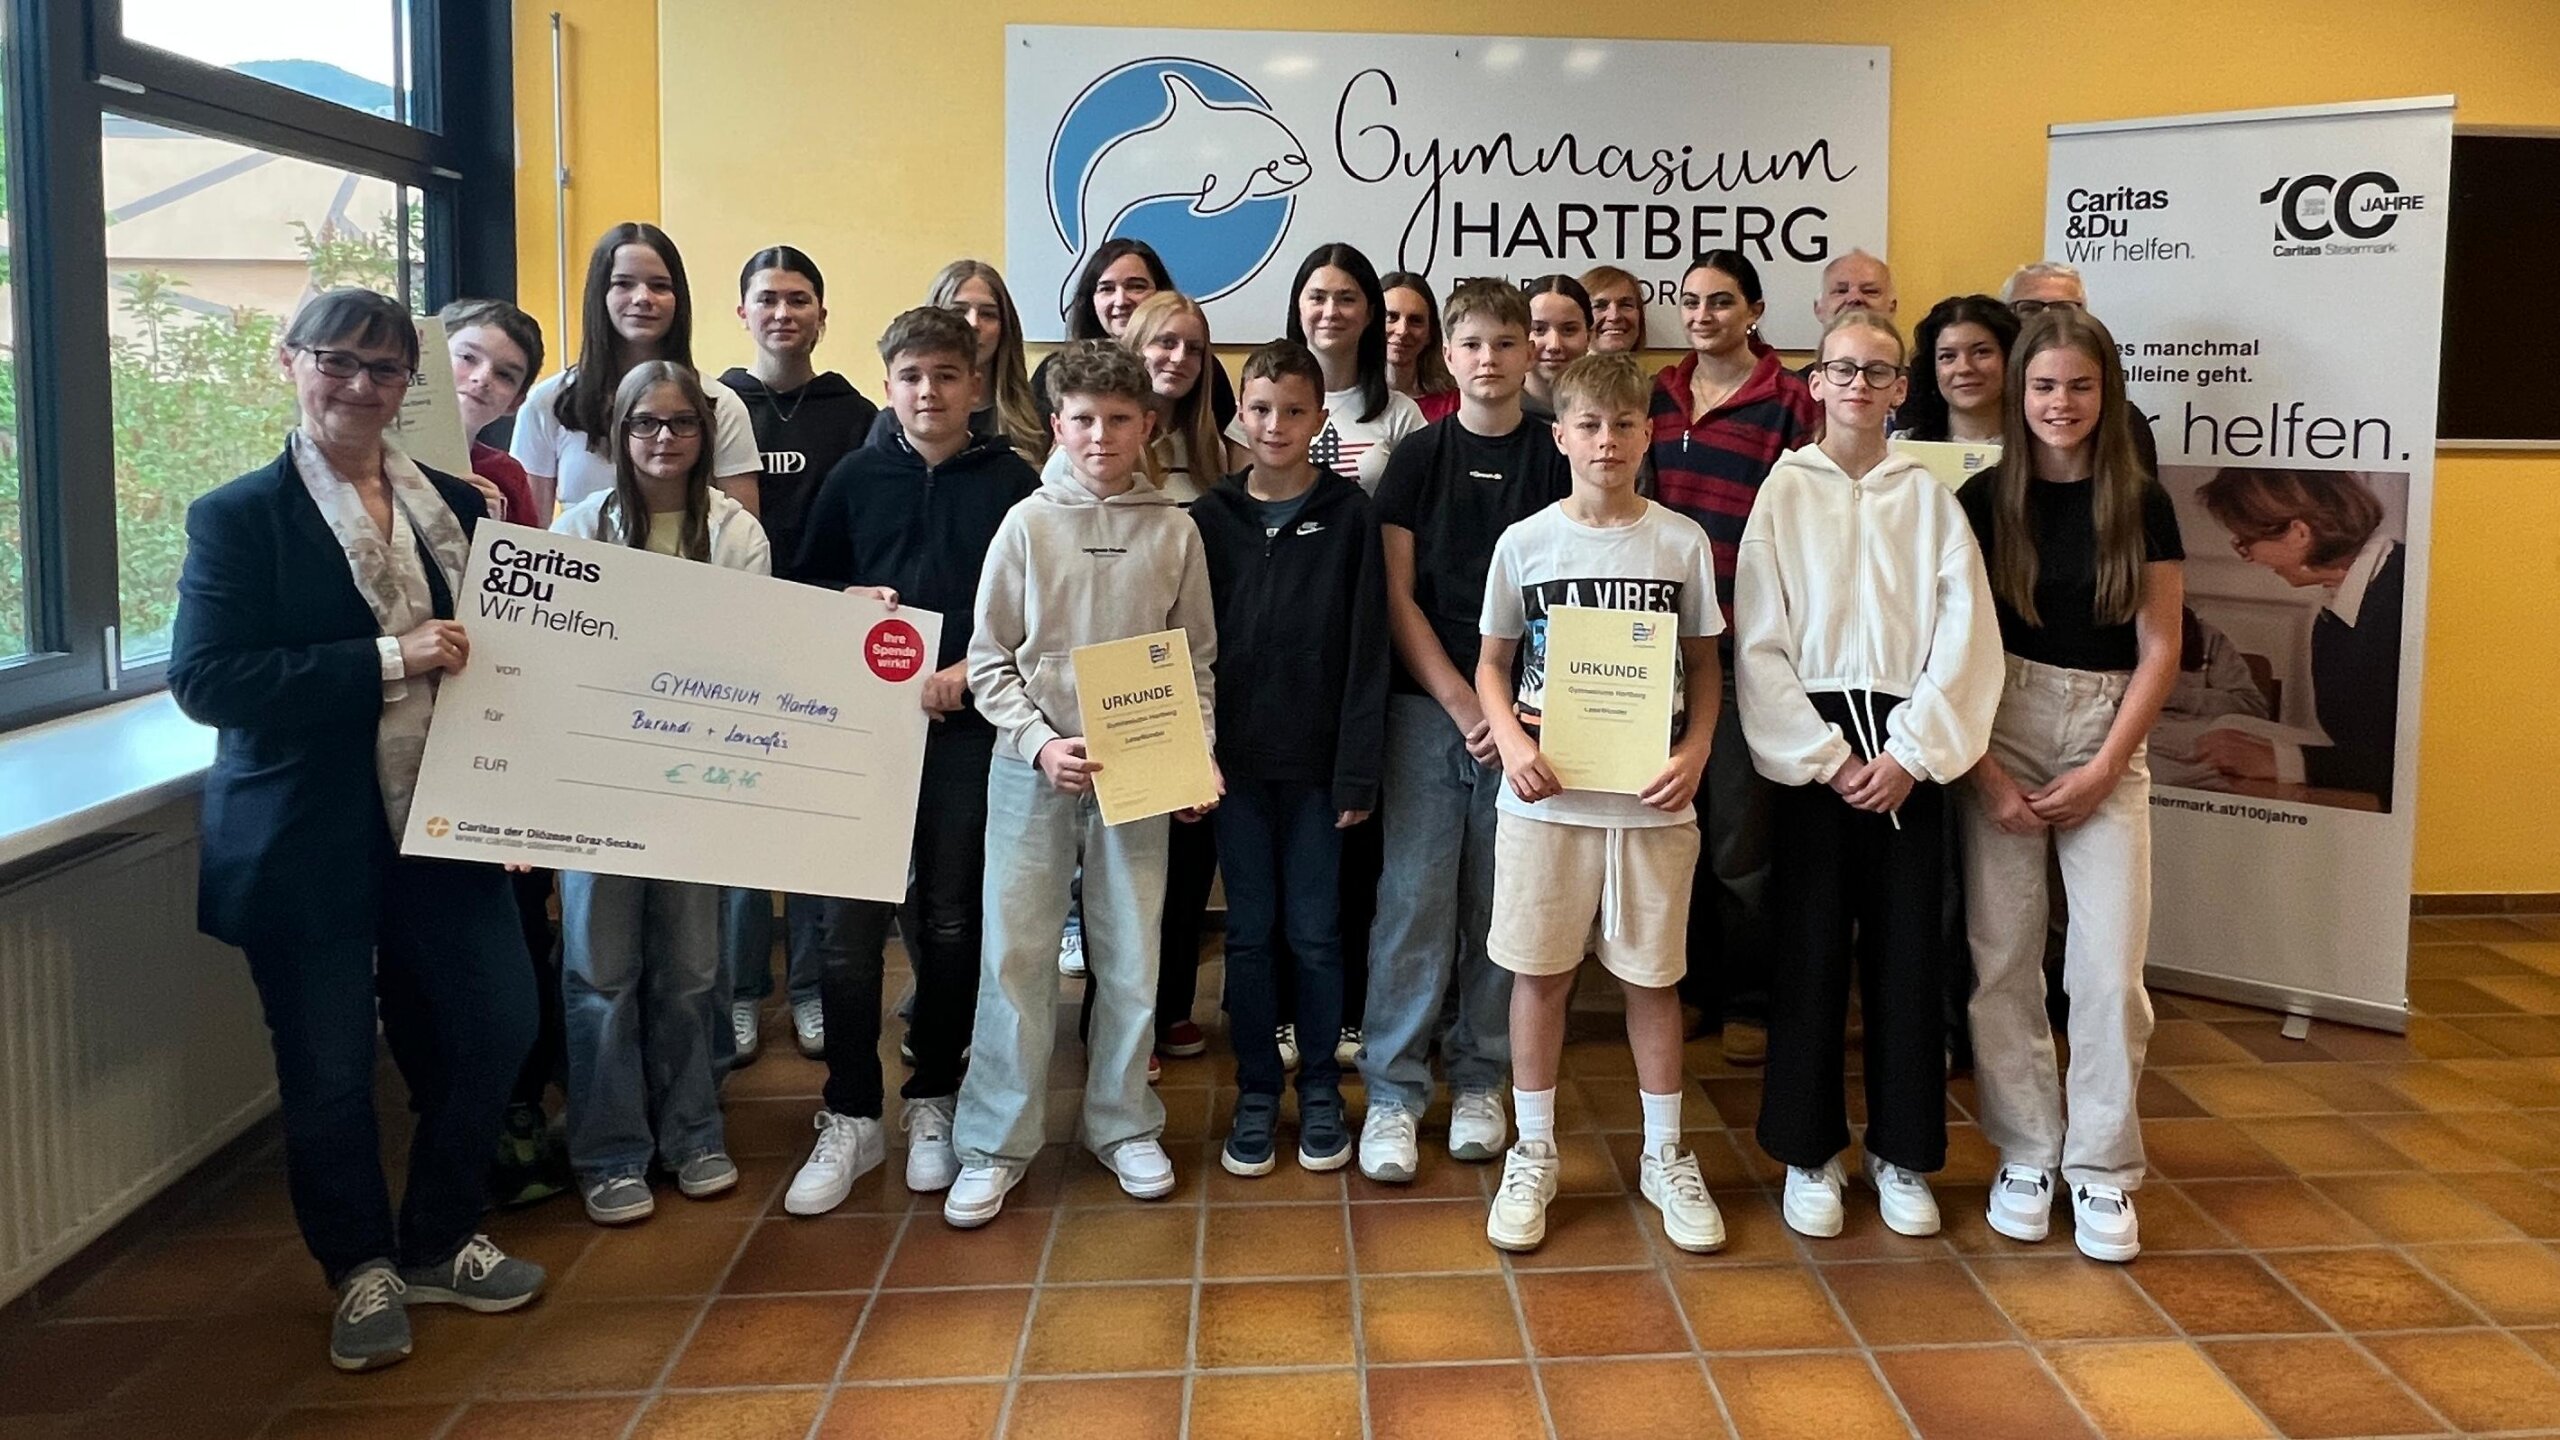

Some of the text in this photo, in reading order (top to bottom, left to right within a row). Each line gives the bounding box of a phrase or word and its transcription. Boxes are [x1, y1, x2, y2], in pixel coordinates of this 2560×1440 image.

[1334, 68, 1857, 275] Gymnasium
[2067, 186, 2169, 213] Caritas
[2360, 195, 2425, 212] JAHRE
[1453, 201, 1829, 263] HARTBERG
[2065, 213, 2128, 239] &Du
[2065, 237, 2195, 263] Wir helfen.
[2273, 243, 2397, 257] Caritas Steiermark
[2143, 339, 2259, 356] manchmal
[2197, 365, 2253, 387] geht.
[2183, 402, 2410, 460] helfen.
[489, 539, 601, 583] Caritas
[483, 567, 554, 602] &Du
[1593, 582, 1675, 614] VIBES
[480, 592, 618, 641] Wir helfen.
[872, 643, 917, 658] Spende
[883, 632, 907, 645] Ihre
[496, 664, 521, 676] von
[877, 658, 911, 669] wirkt!
[1570, 661, 1648, 680] URKUNDE
[651, 672, 838, 722] GYMNASIUM Hartberg
[1102, 684, 1175, 710] URKUNDE
[484, 708, 504, 722] für
[473, 756, 508, 772] EUR
[665, 763, 696, 784] €
[2149, 794, 2308, 826] eiermark.at/100jahre
[458, 821, 646, 850] Caritas der Diözese Graz-Seckau
